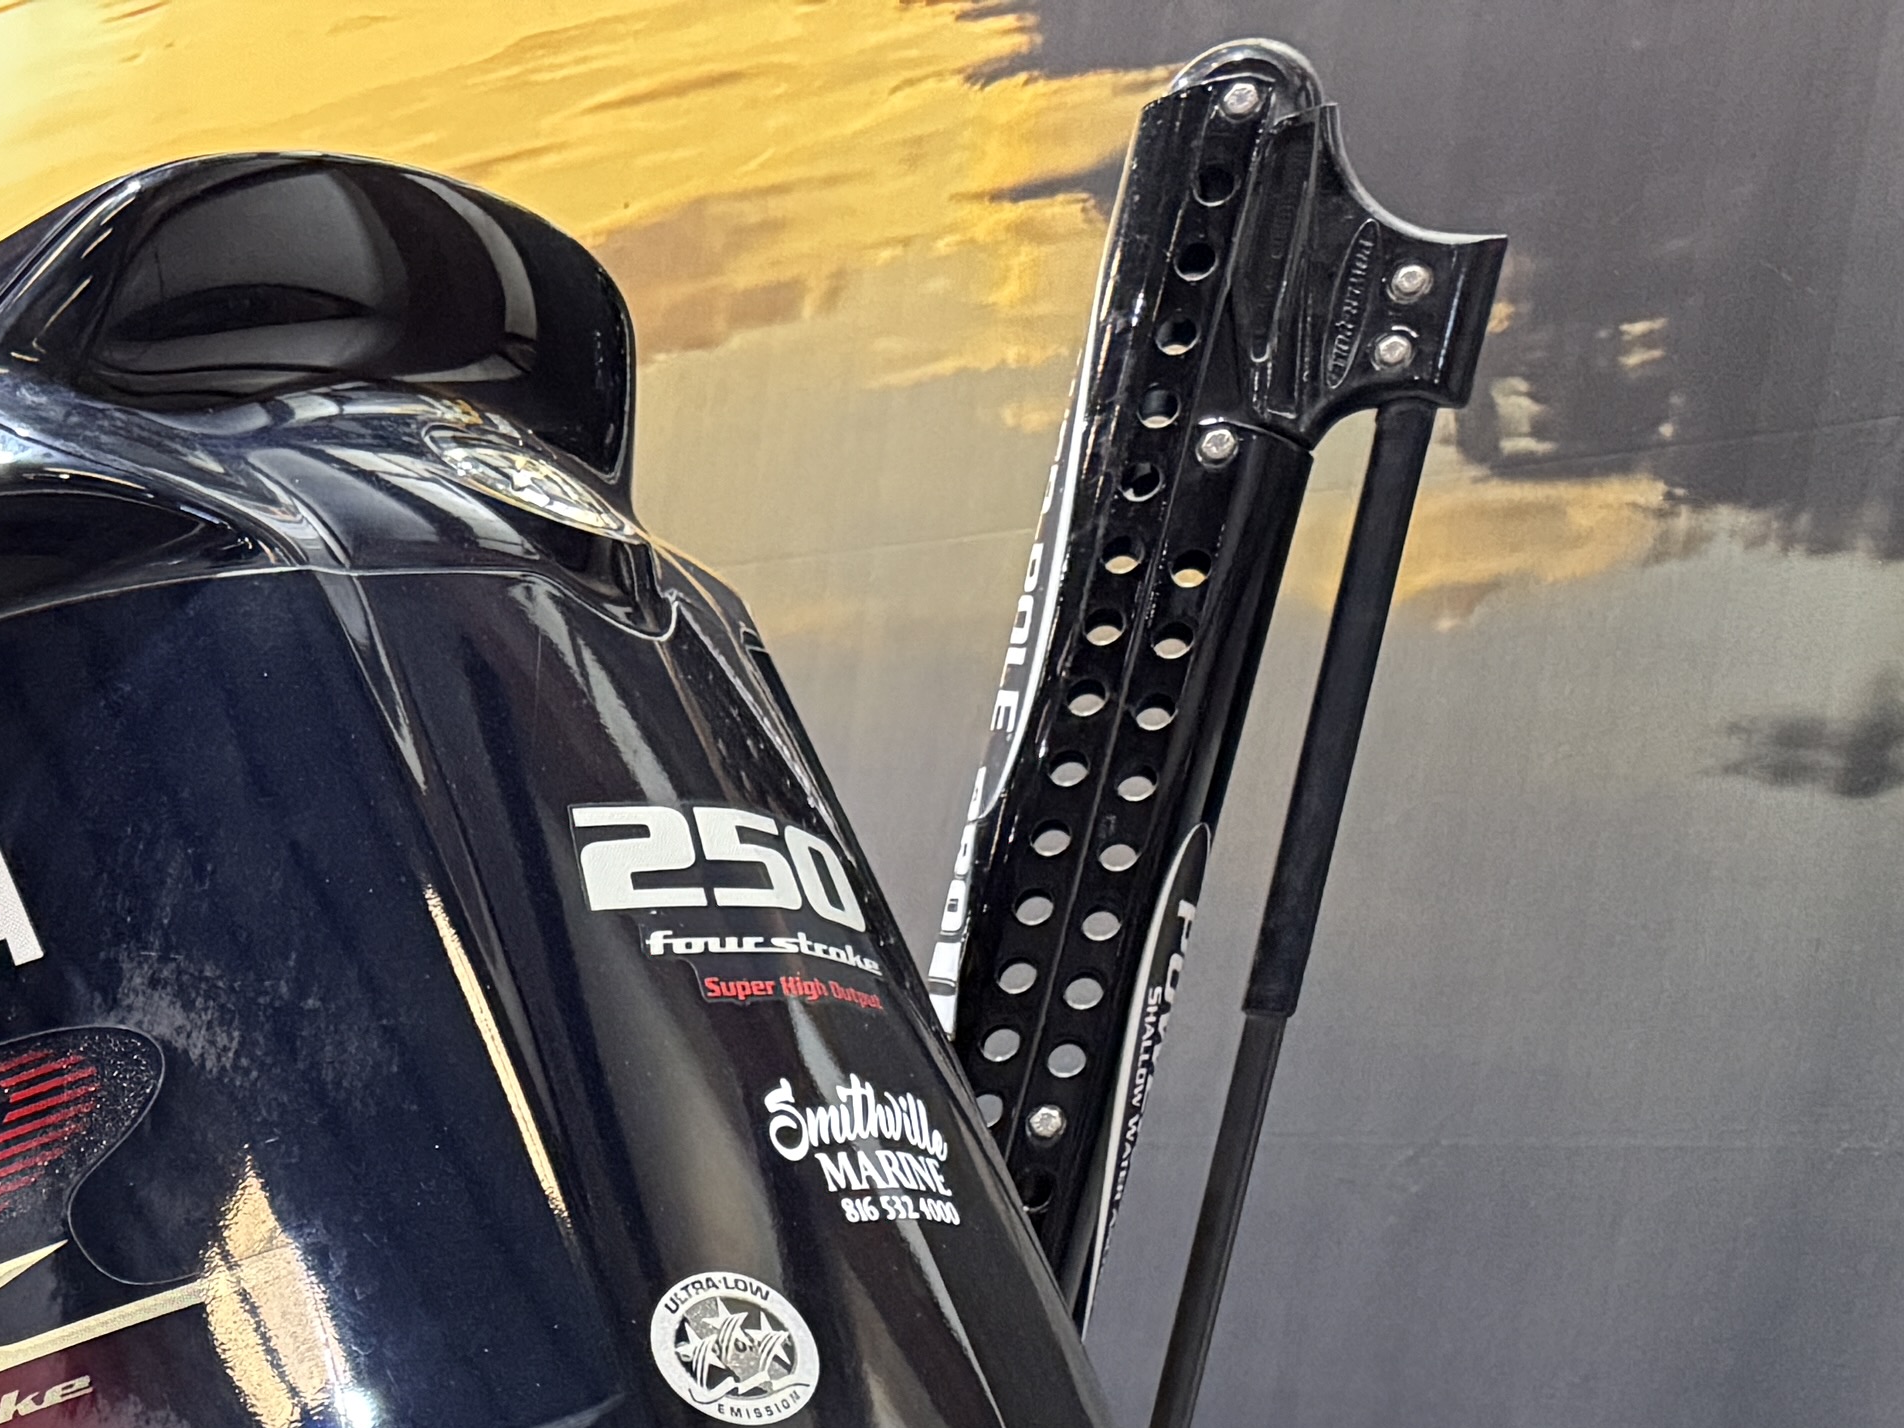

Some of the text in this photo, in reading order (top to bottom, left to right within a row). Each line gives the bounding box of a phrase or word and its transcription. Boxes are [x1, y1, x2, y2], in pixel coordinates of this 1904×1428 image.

[571, 806, 866, 933] 250
[704, 975, 883, 1011] Super High Output
[764, 1074, 949, 1162] Smithville
[814, 1149, 953, 1197] MARINE
[841, 1196, 961, 1227] 816 532 4000
[717, 1389, 802, 1420] EMISSION
